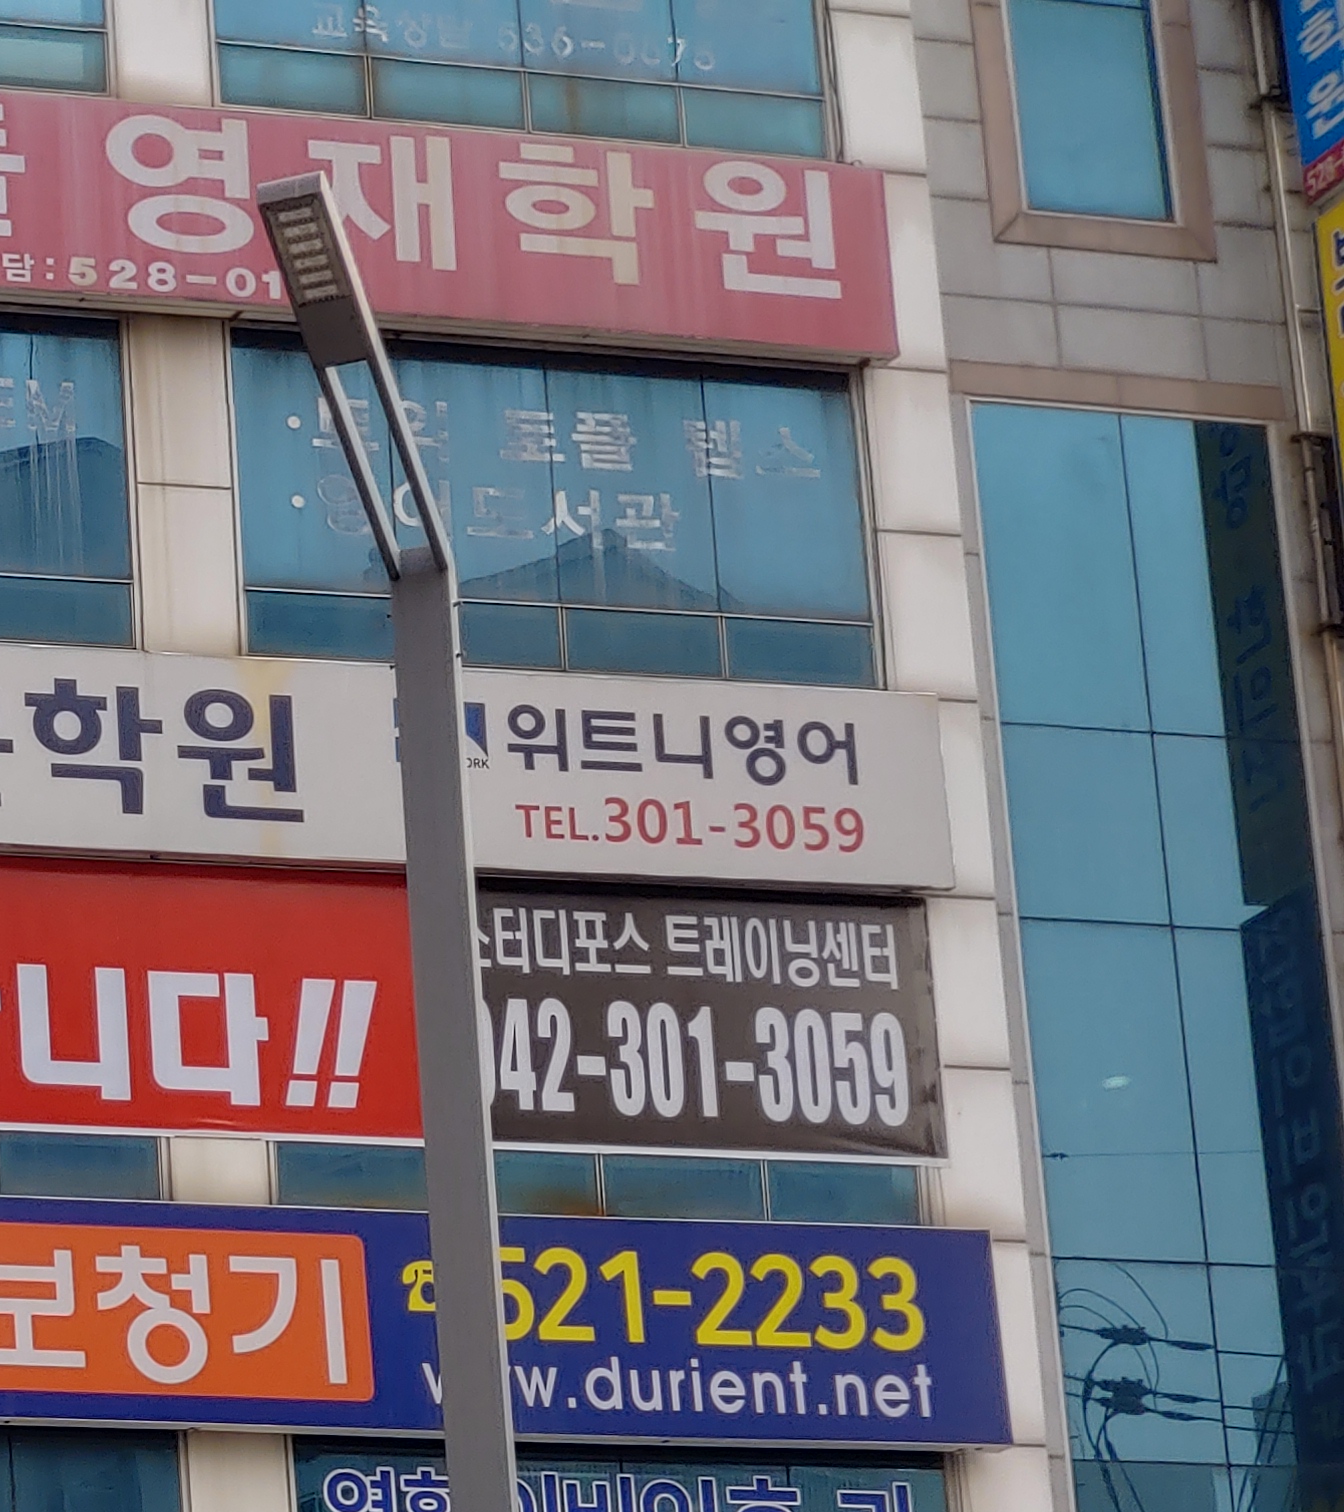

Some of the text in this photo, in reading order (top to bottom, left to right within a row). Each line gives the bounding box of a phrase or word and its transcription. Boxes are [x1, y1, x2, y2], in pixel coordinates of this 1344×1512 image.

[506, 703, 859, 787] 위트니영어
[515, 797, 866, 854] TEL.301-3059
[666, 913, 899, 990] 트레이닝센터
[423, 1356, 932, 1419] w.durient.net
